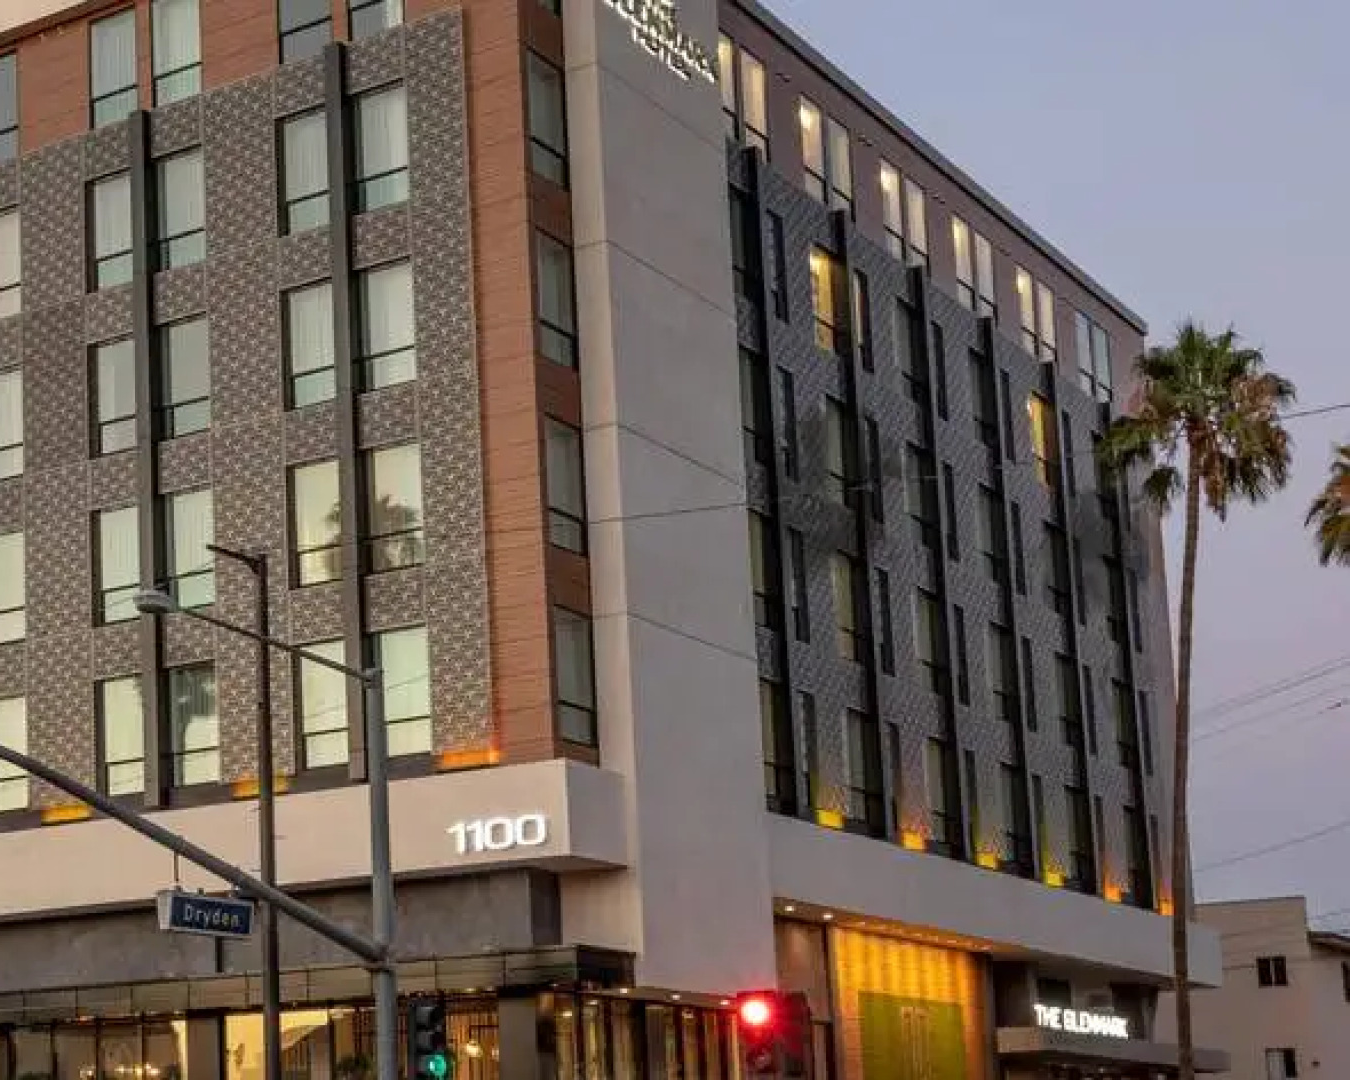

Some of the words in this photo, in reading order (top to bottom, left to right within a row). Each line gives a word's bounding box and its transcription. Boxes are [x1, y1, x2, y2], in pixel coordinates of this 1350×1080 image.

[446, 813, 547, 855] 1100
[183, 903, 239, 928] Dryden
[1033, 1003, 1063, 1030] THE
